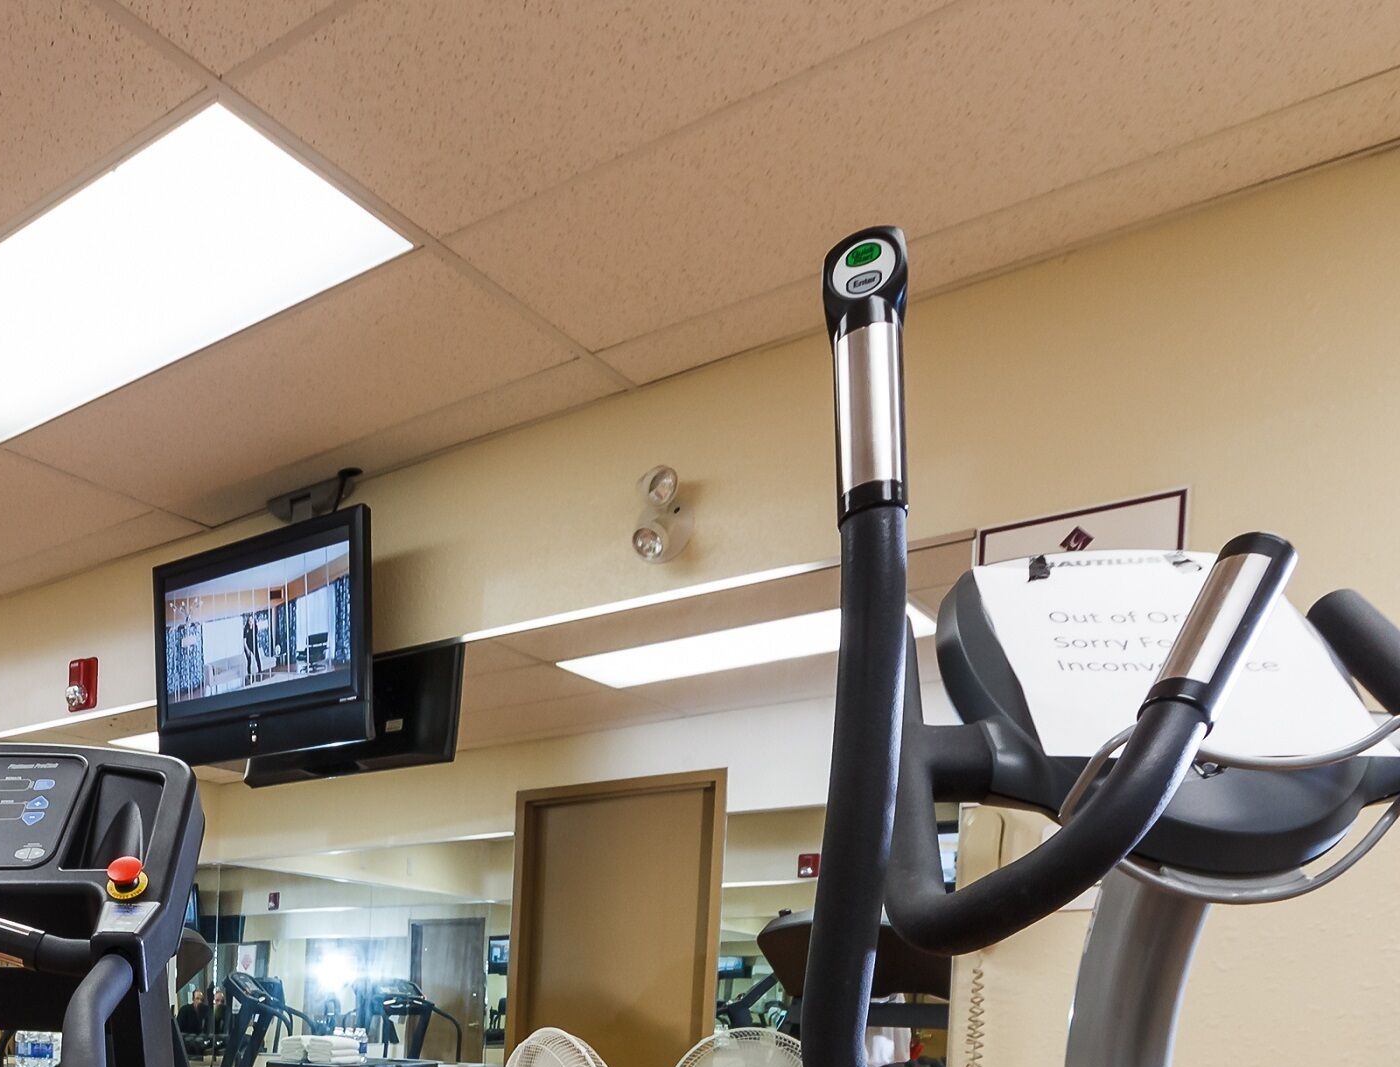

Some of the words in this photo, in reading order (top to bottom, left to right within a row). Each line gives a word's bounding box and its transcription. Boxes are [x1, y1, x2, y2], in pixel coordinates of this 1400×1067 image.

[853, 276, 876, 288] Enter
[1049, 611, 1101, 623] Out
[1110, 611, 1137, 623] of
[1147, 611, 1185, 623] Or
[1054, 636, 1128, 650] Sorry
[1140, 636, 1174, 648] Fo
[1057, 659, 1280, 672] Inconvce
